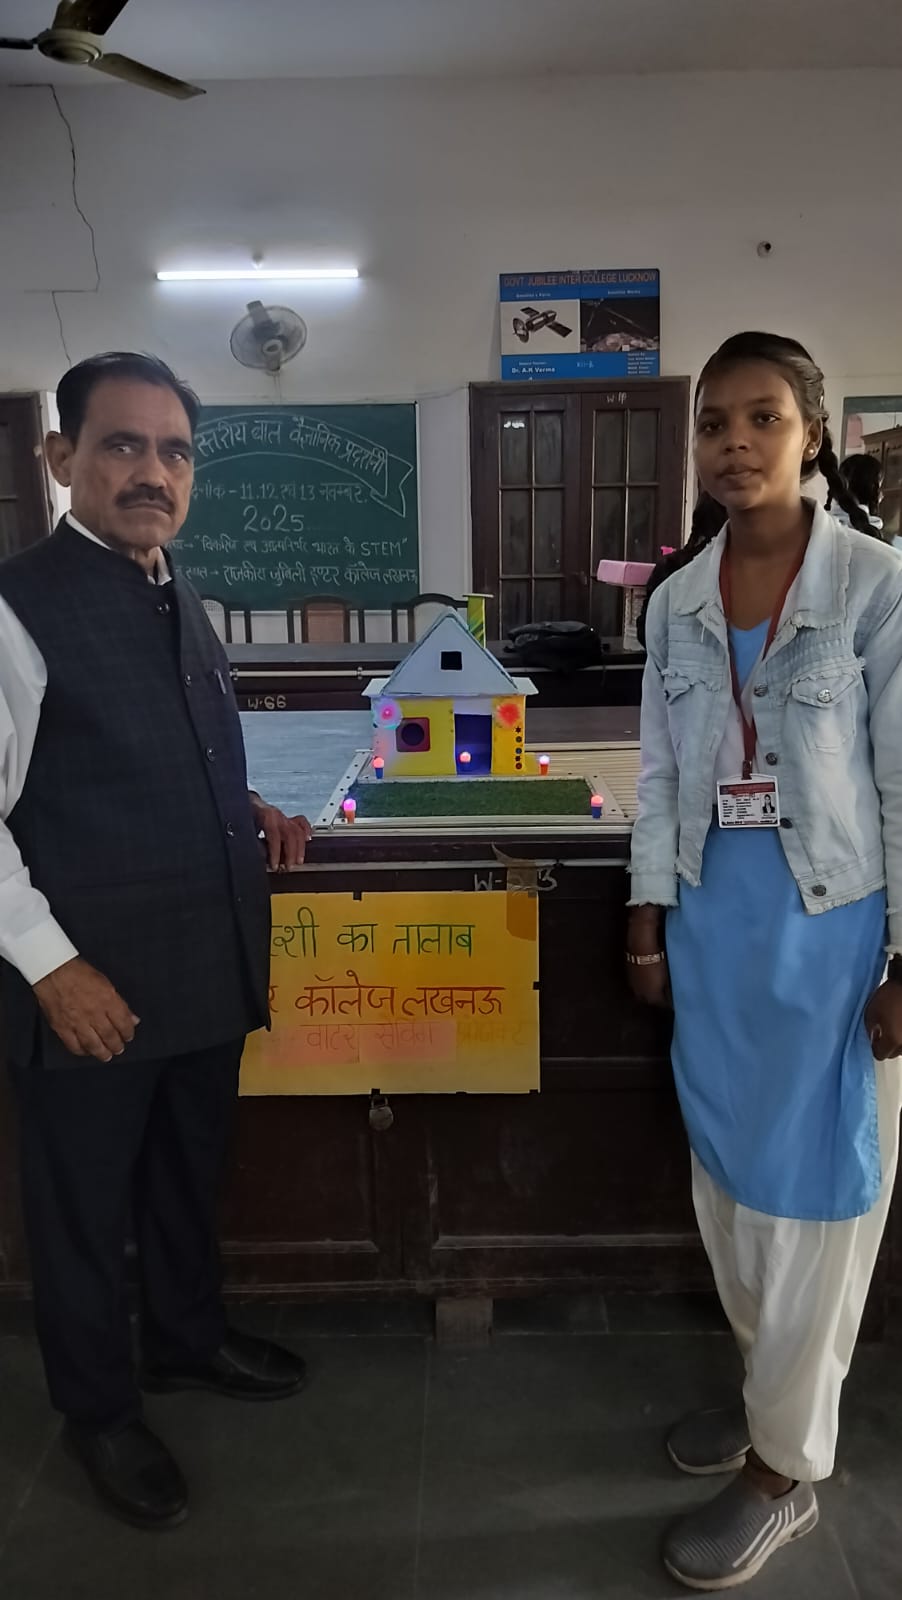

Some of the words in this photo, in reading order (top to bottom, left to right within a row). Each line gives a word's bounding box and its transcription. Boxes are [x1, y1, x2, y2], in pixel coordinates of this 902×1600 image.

[504, 277, 524, 287] GOVT
[528, 275, 558, 286] JUBILEE
[559, 273, 581, 285] INTER
[582, 272, 617, 284] COLLEGE
[619, 271, 657, 282] LUCKNOW
[300, 483, 316, 501] 13
[243, 503, 305, 533] 2025
[337, 923, 378, 954] का
[392, 924, 476, 959] तालाब
[295, 969, 398, 1018] कॉलेज
[402, 986, 506, 1017] लखनऊ
